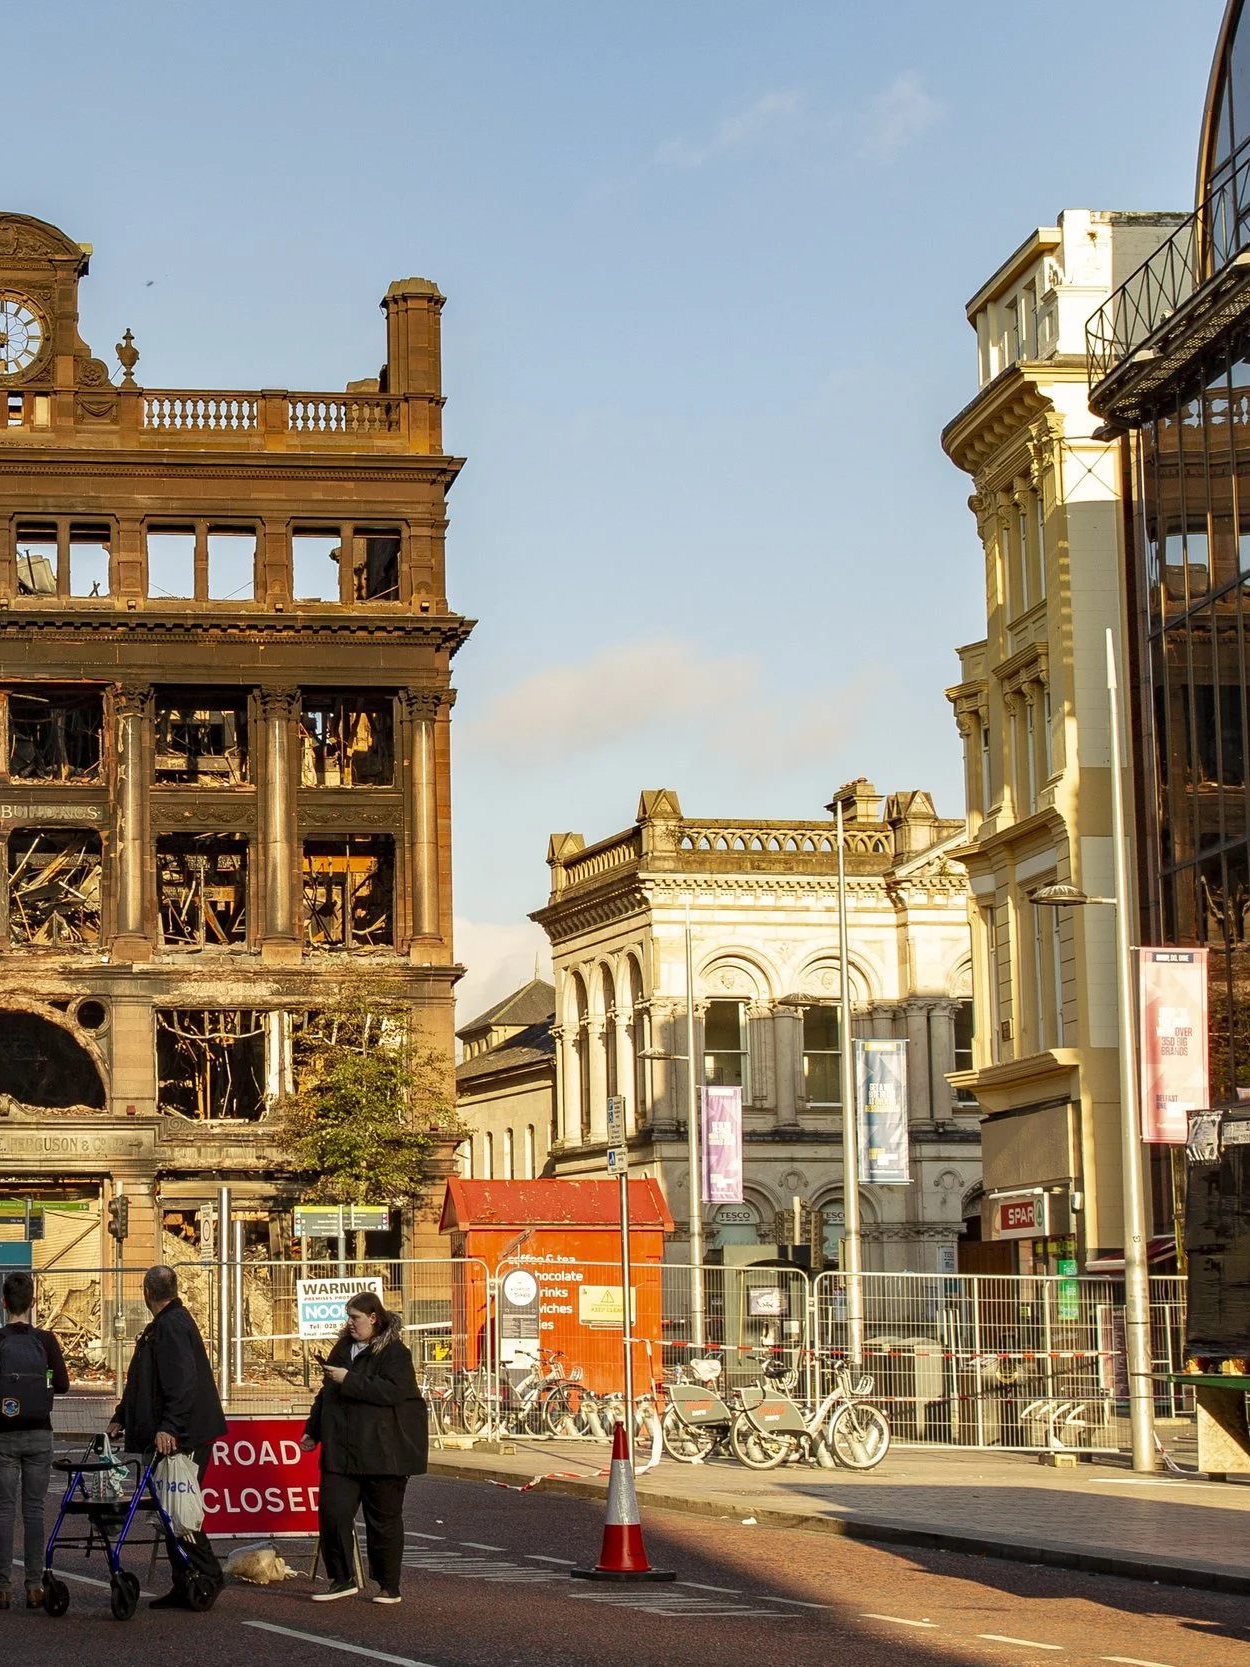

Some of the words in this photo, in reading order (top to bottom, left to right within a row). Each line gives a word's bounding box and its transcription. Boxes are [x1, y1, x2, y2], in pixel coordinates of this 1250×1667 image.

[1174, 1027, 1193, 1036] OVER
[1162, 1037, 1175, 1046] 350
[1176, 1037, 1188, 1046] BIG
[1161, 1047, 1188, 1056] BRANDS
[719, 1211, 751, 1219] TESCO
[1008, 1206, 1034, 1225] SPAR
[557, 1254, 576, 1264] tea
[535, 1270, 584, 1281] hocolate
[303, 1281, 377, 1295] WARNING
[540, 1287, 569, 1297] rinks
[305, 1303, 347, 1320] NOO
[212, 1440, 301, 1466] ROAD
